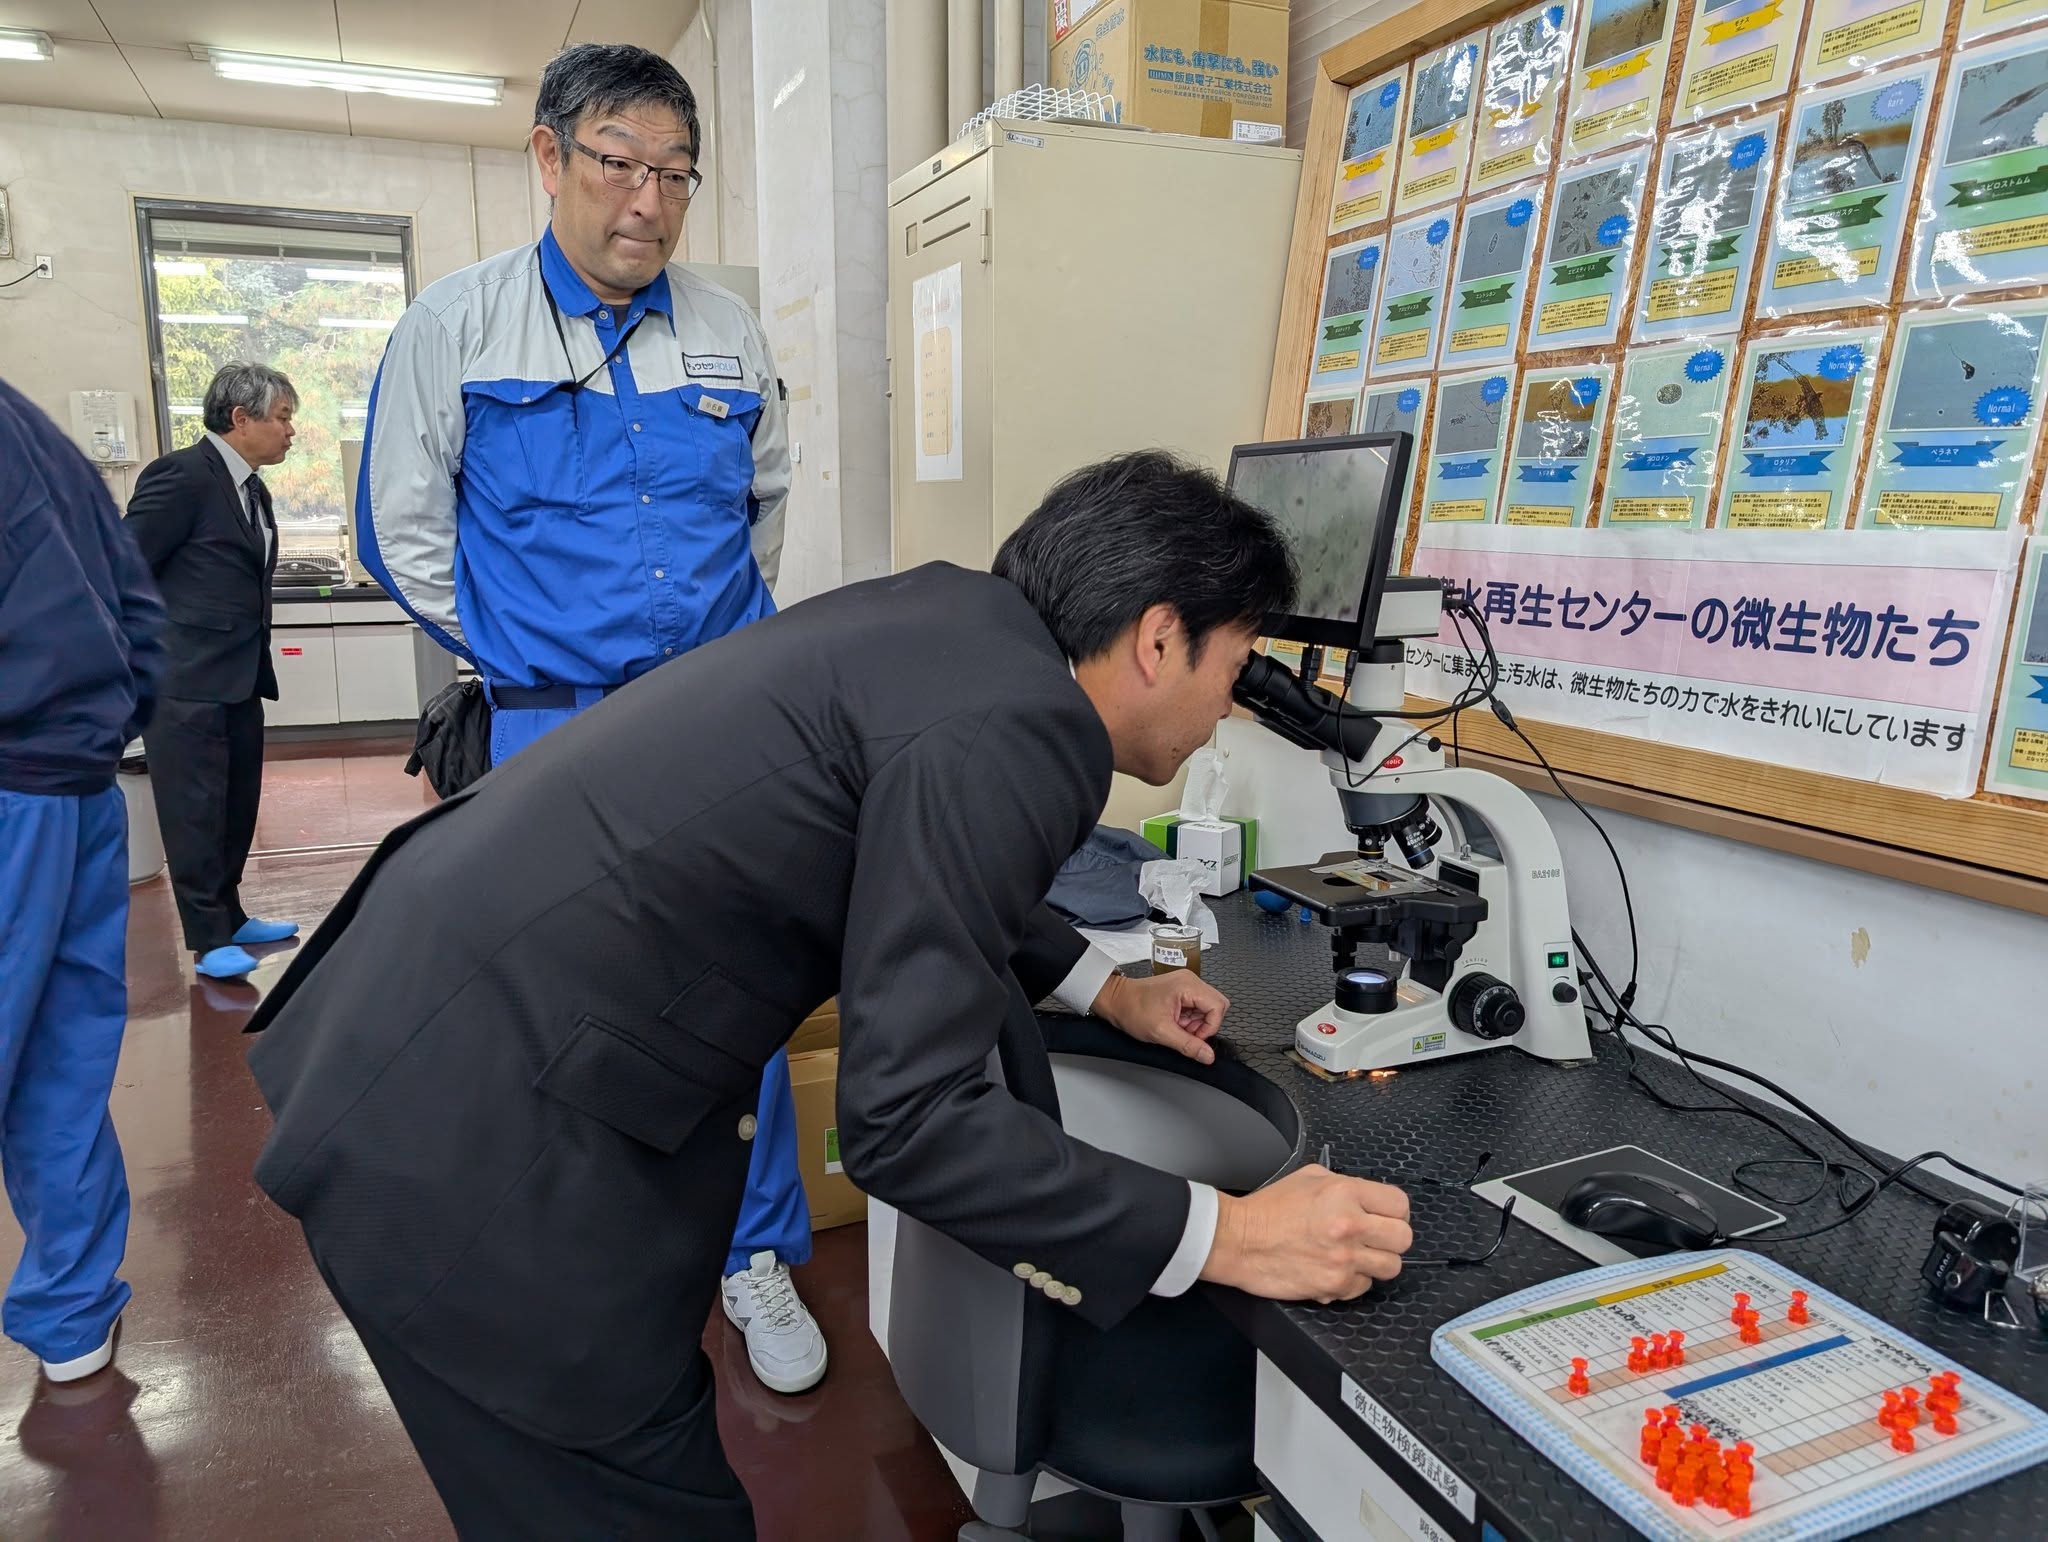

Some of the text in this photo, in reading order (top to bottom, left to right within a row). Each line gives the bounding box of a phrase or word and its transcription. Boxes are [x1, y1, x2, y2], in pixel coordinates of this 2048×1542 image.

[1144, 44, 1280, 78] 水にも、衝撃にも、強い
[1174, 71, 1273, 95] 飯島電子工業株式会社
[1886, 97, 1904, 108] Rare
[1736, 149, 1757, 161] Normal
[1604, 228, 1624, 237] Norma
[1693, 363, 1715, 374] Normal
[1987, 403, 2017, 414] Normal
[1773, 458, 1797, 466] ロタリア
[1531, 868, 1561, 879] BA210E
[1353, 1389, 1459, 1504] 微生物検鏡試験
[1419, 1516, 1450, 1542] 顕微
